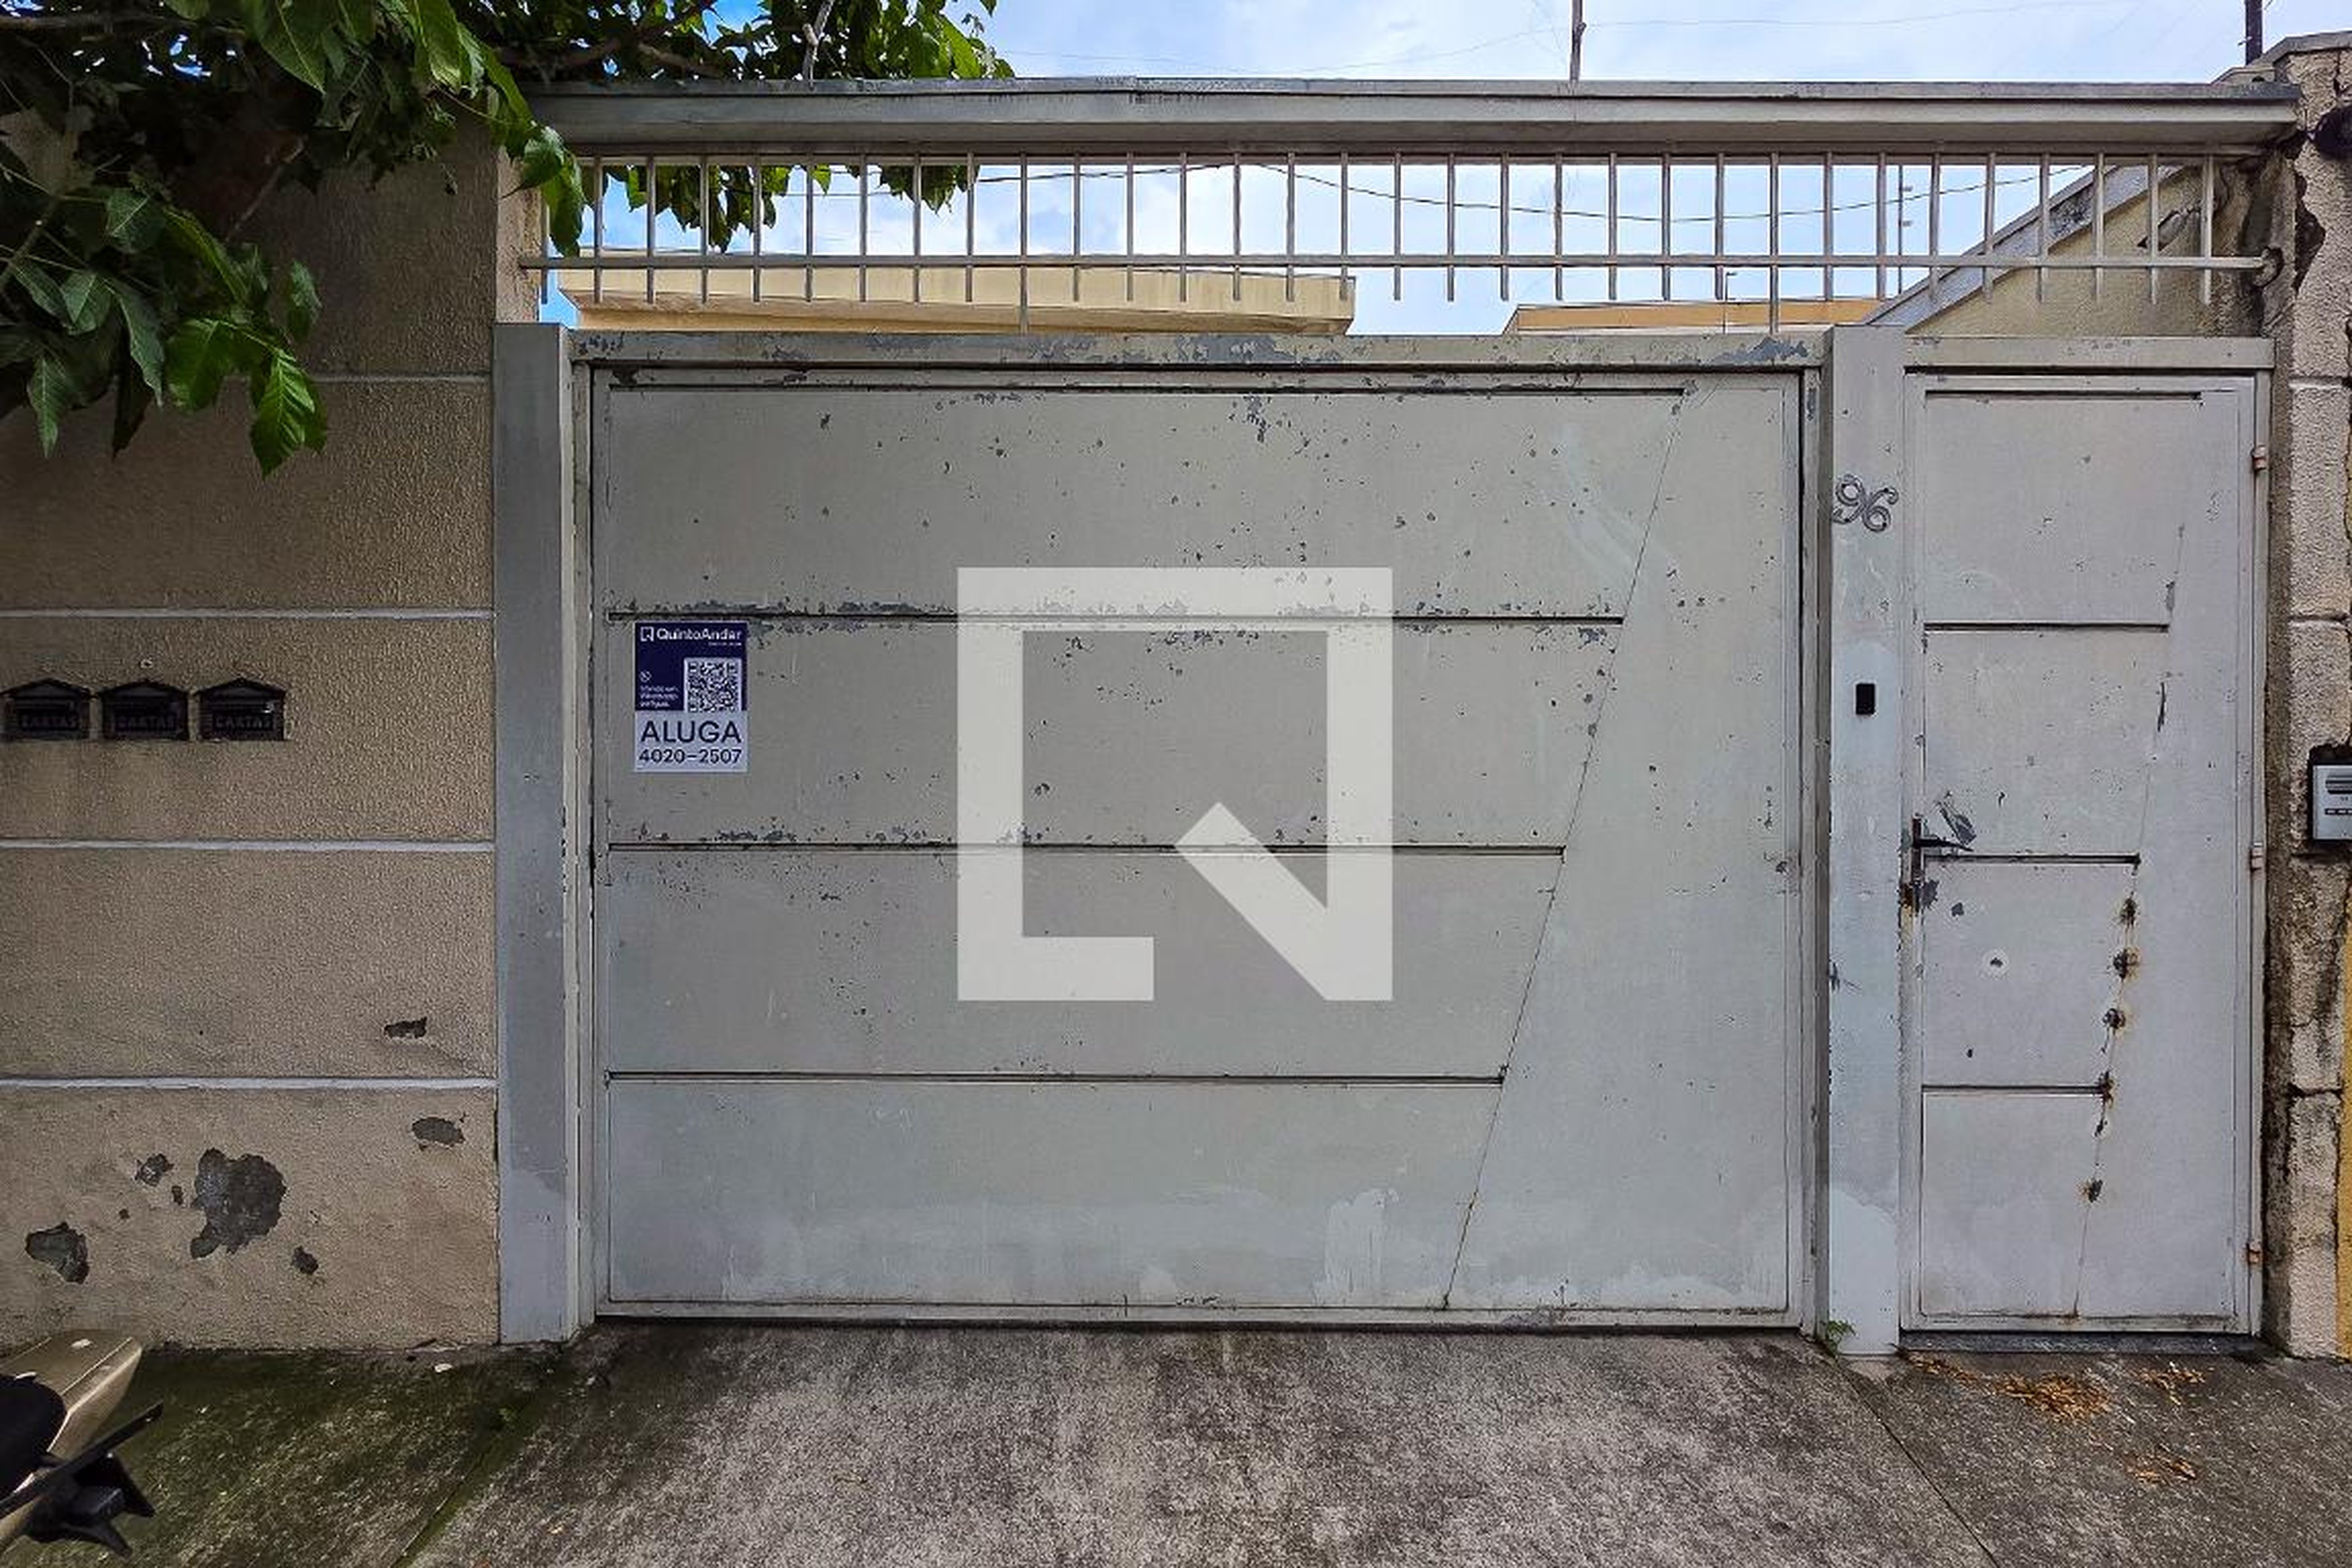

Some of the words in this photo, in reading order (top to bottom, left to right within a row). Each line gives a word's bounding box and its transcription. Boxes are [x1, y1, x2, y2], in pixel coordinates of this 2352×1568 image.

[1830, 473, 1899, 533] 96
[656, 628, 742, 641] QuintoAndar
[641, 720, 742, 744] ALUGA
[639, 748, 742, 764] 4020-2507
